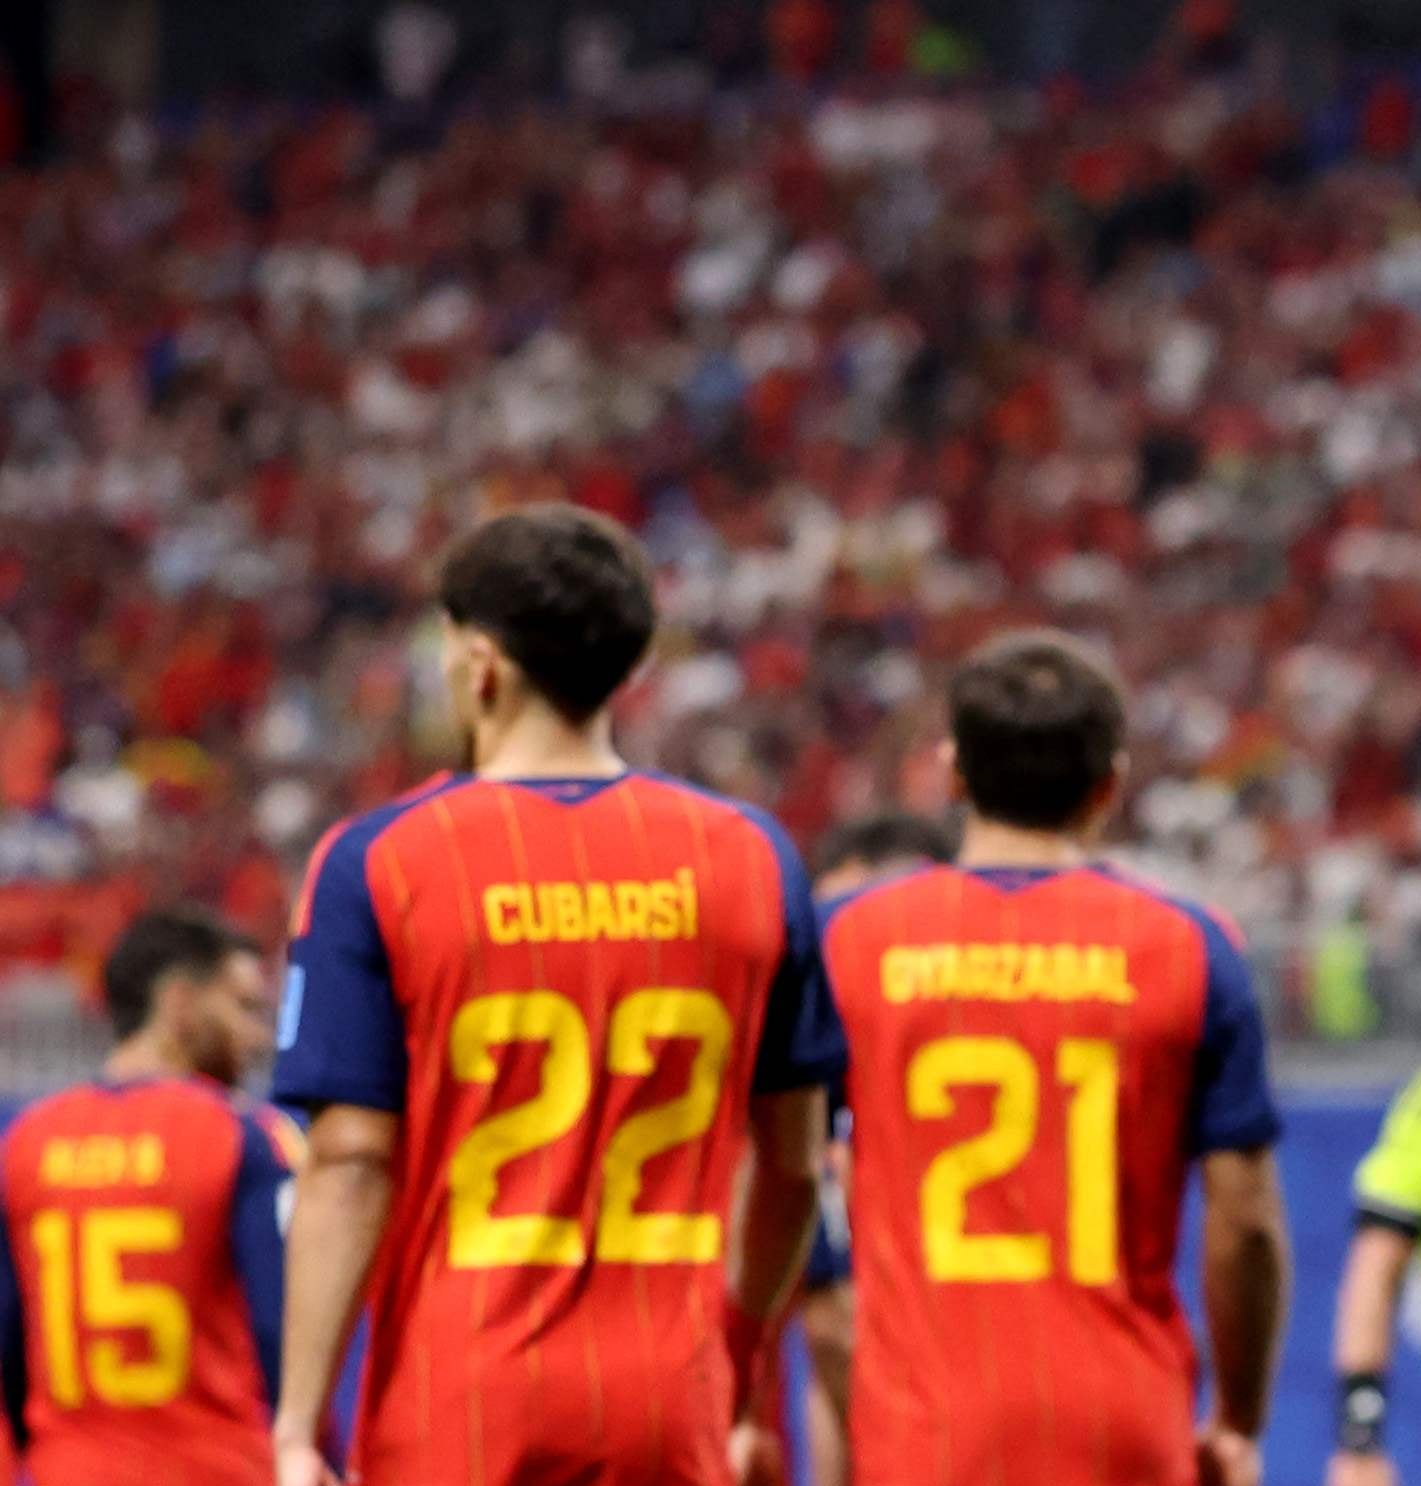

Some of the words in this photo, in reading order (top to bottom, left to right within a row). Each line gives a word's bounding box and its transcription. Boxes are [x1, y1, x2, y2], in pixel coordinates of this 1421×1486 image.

[483, 867, 698, 945] CUBARSÍ
[448, 988, 731, 1270] 22
[905, 1035, 1118, 1287] 21
[32, 1207, 192, 1408] 15
